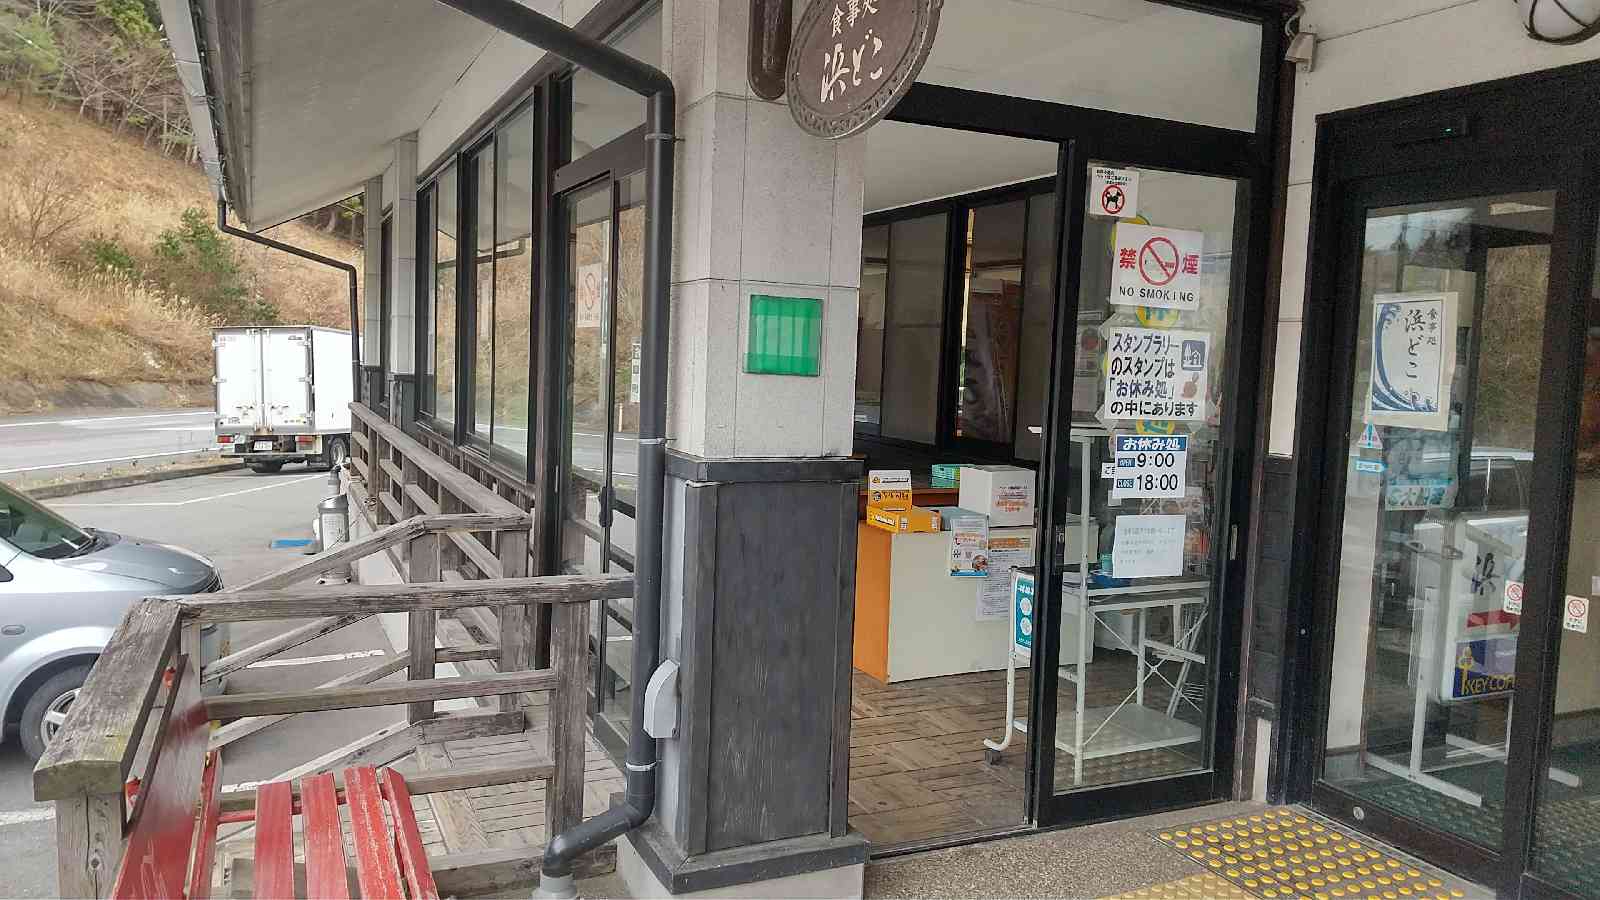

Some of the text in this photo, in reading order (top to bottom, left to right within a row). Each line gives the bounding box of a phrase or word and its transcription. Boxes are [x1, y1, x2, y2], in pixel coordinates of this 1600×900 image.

[820, 28, 884, 103] 浜どこ
[1119, 247, 1200, 275] 禁 煙
[1119, 286, 1194, 302] NO SMOKING
[1425, 307, 1439, 346] 食事処
[1112, 332, 1180, 355] スタンプラリー
[1403, 308, 1426, 379] 浜どこ
[1111, 356, 1176, 379] のスタンプは
[1109, 377, 1175, 400] 「お休み処」
[1110, 401, 1198, 417] の中にあります
[1122, 437, 1181, 451] お休み処
[1136, 452, 1175, 468] 9:00
[1136, 474, 1178, 491] 18:00
